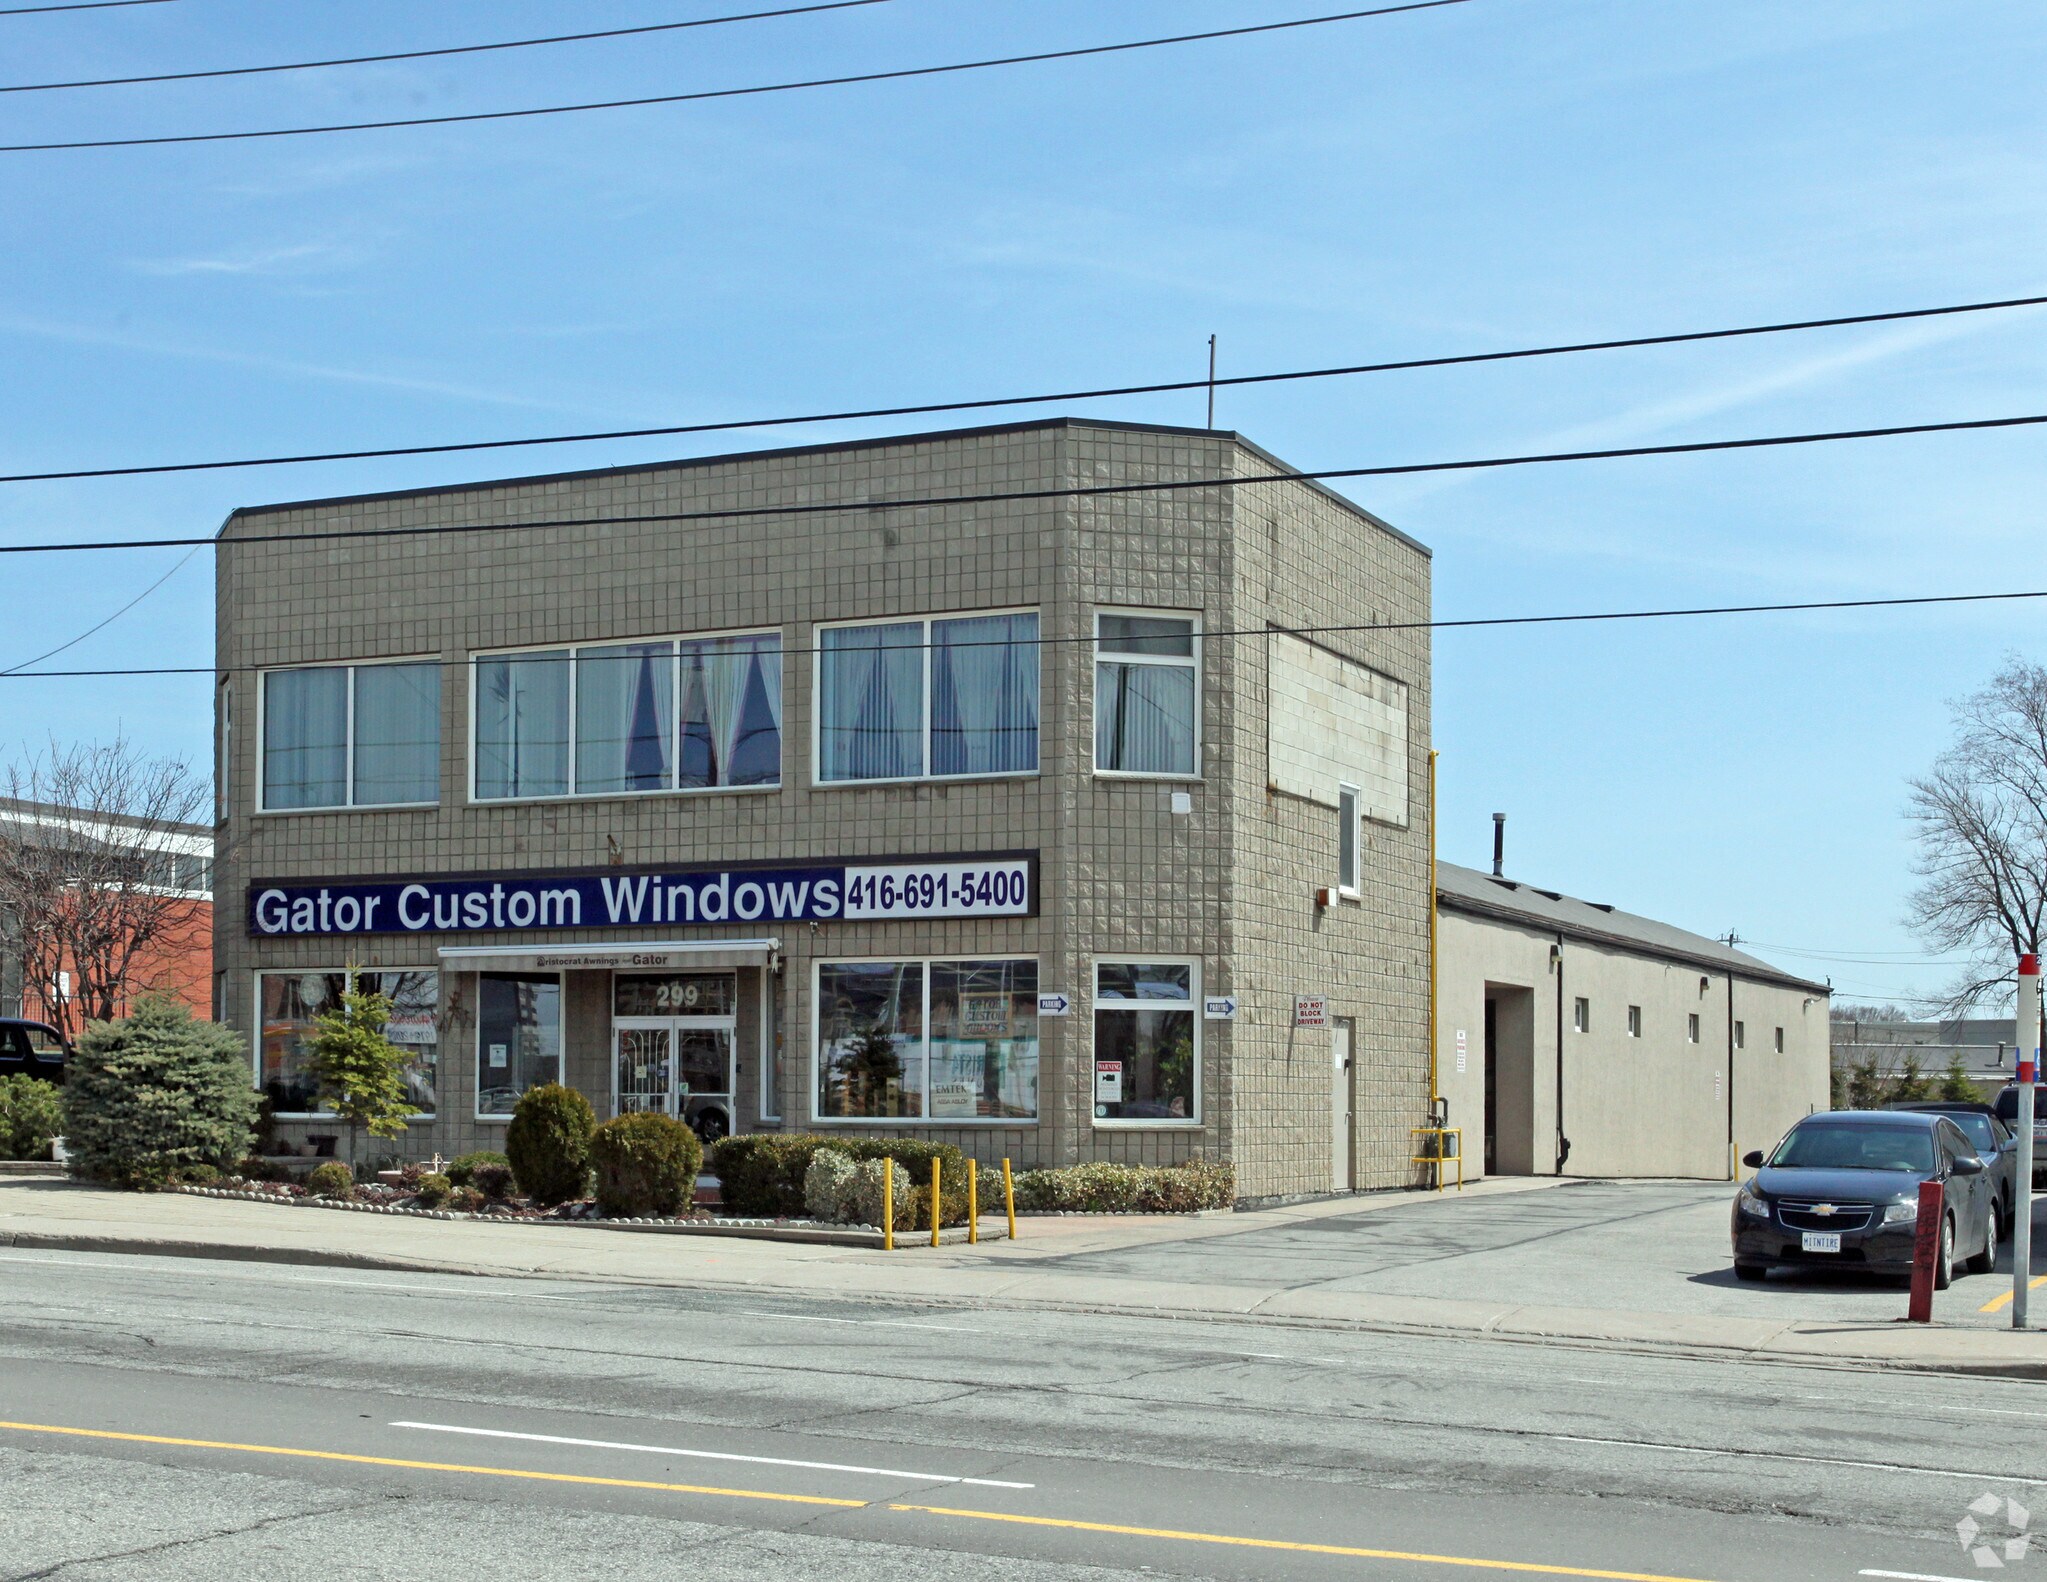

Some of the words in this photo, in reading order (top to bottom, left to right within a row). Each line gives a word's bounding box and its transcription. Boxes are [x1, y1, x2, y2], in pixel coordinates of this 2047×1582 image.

[847, 870, 1025, 910] 416-691-5400
[256, 888, 381, 933] Gator
[398, 883, 581, 930] Custom
[600, 872, 840, 923] Windows
[537, 955, 582, 967] Aristocrat
[583, 956, 619, 967] Awnings
[632, 954, 668, 965] Gator
[656, 985, 698, 1007] 299
[1042, 1000, 1062, 1009] PARKING
[1209, 1003, 1229, 1012] PARKING
[936, 1085, 968, 1094] EMTEK
